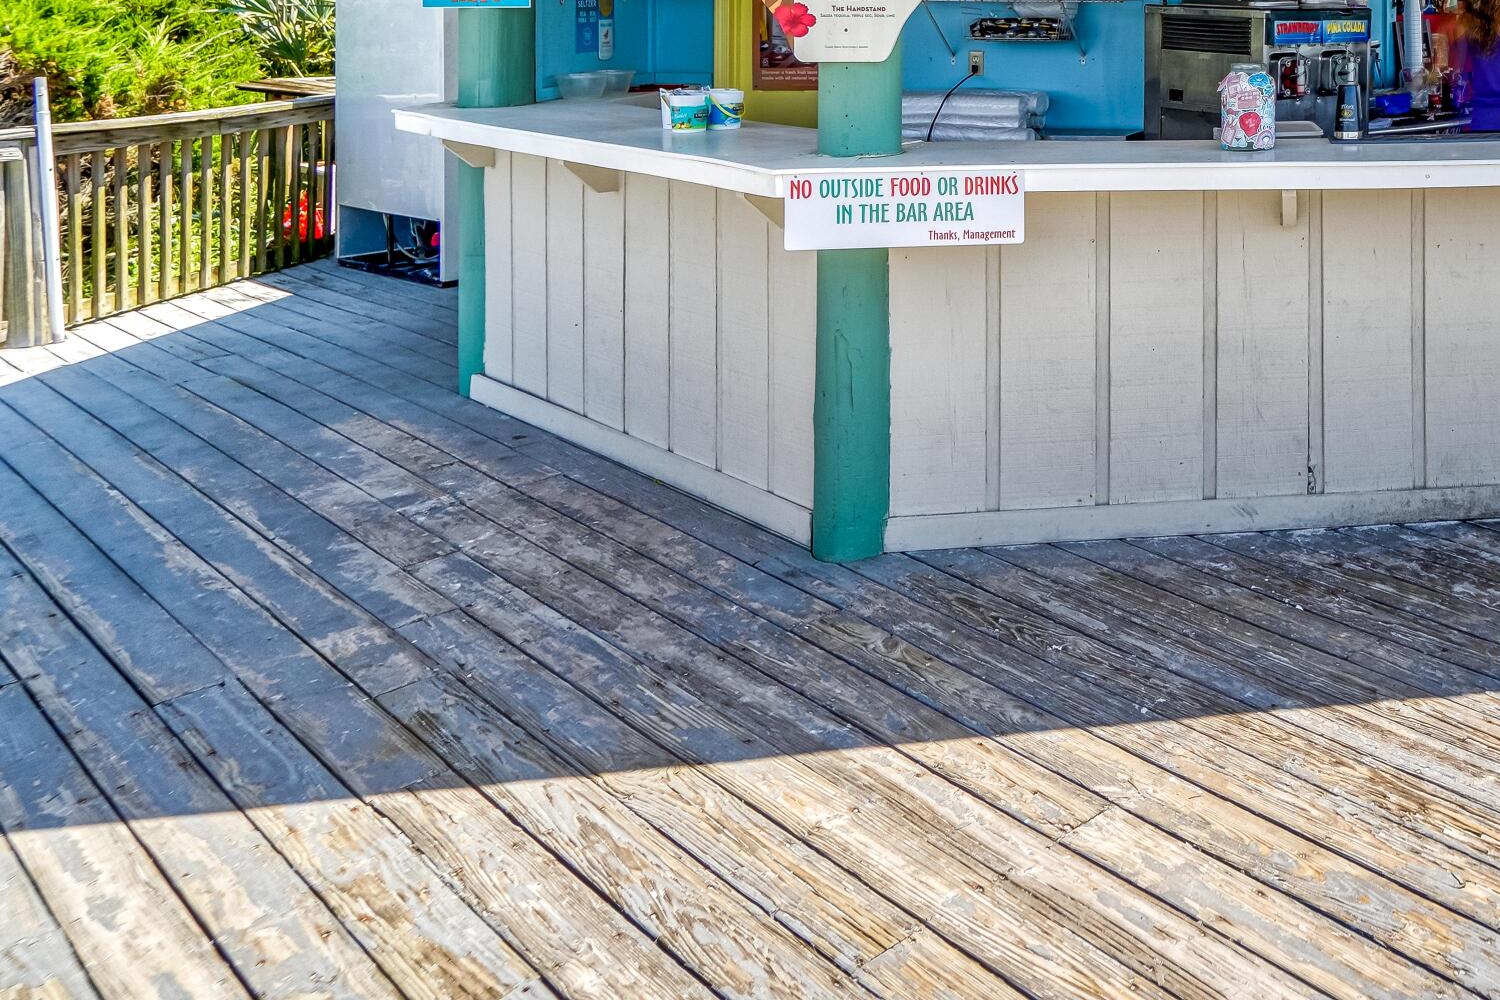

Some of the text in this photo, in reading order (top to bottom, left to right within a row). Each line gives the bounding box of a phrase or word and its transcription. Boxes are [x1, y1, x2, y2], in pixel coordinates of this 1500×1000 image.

[790, 175, 1019, 199] NO OUTSIDE FOOD OR DRINKS
[837, 202, 974, 224] IN THE BAR AREA
[928, 229, 1015, 241] Thanks, Management
